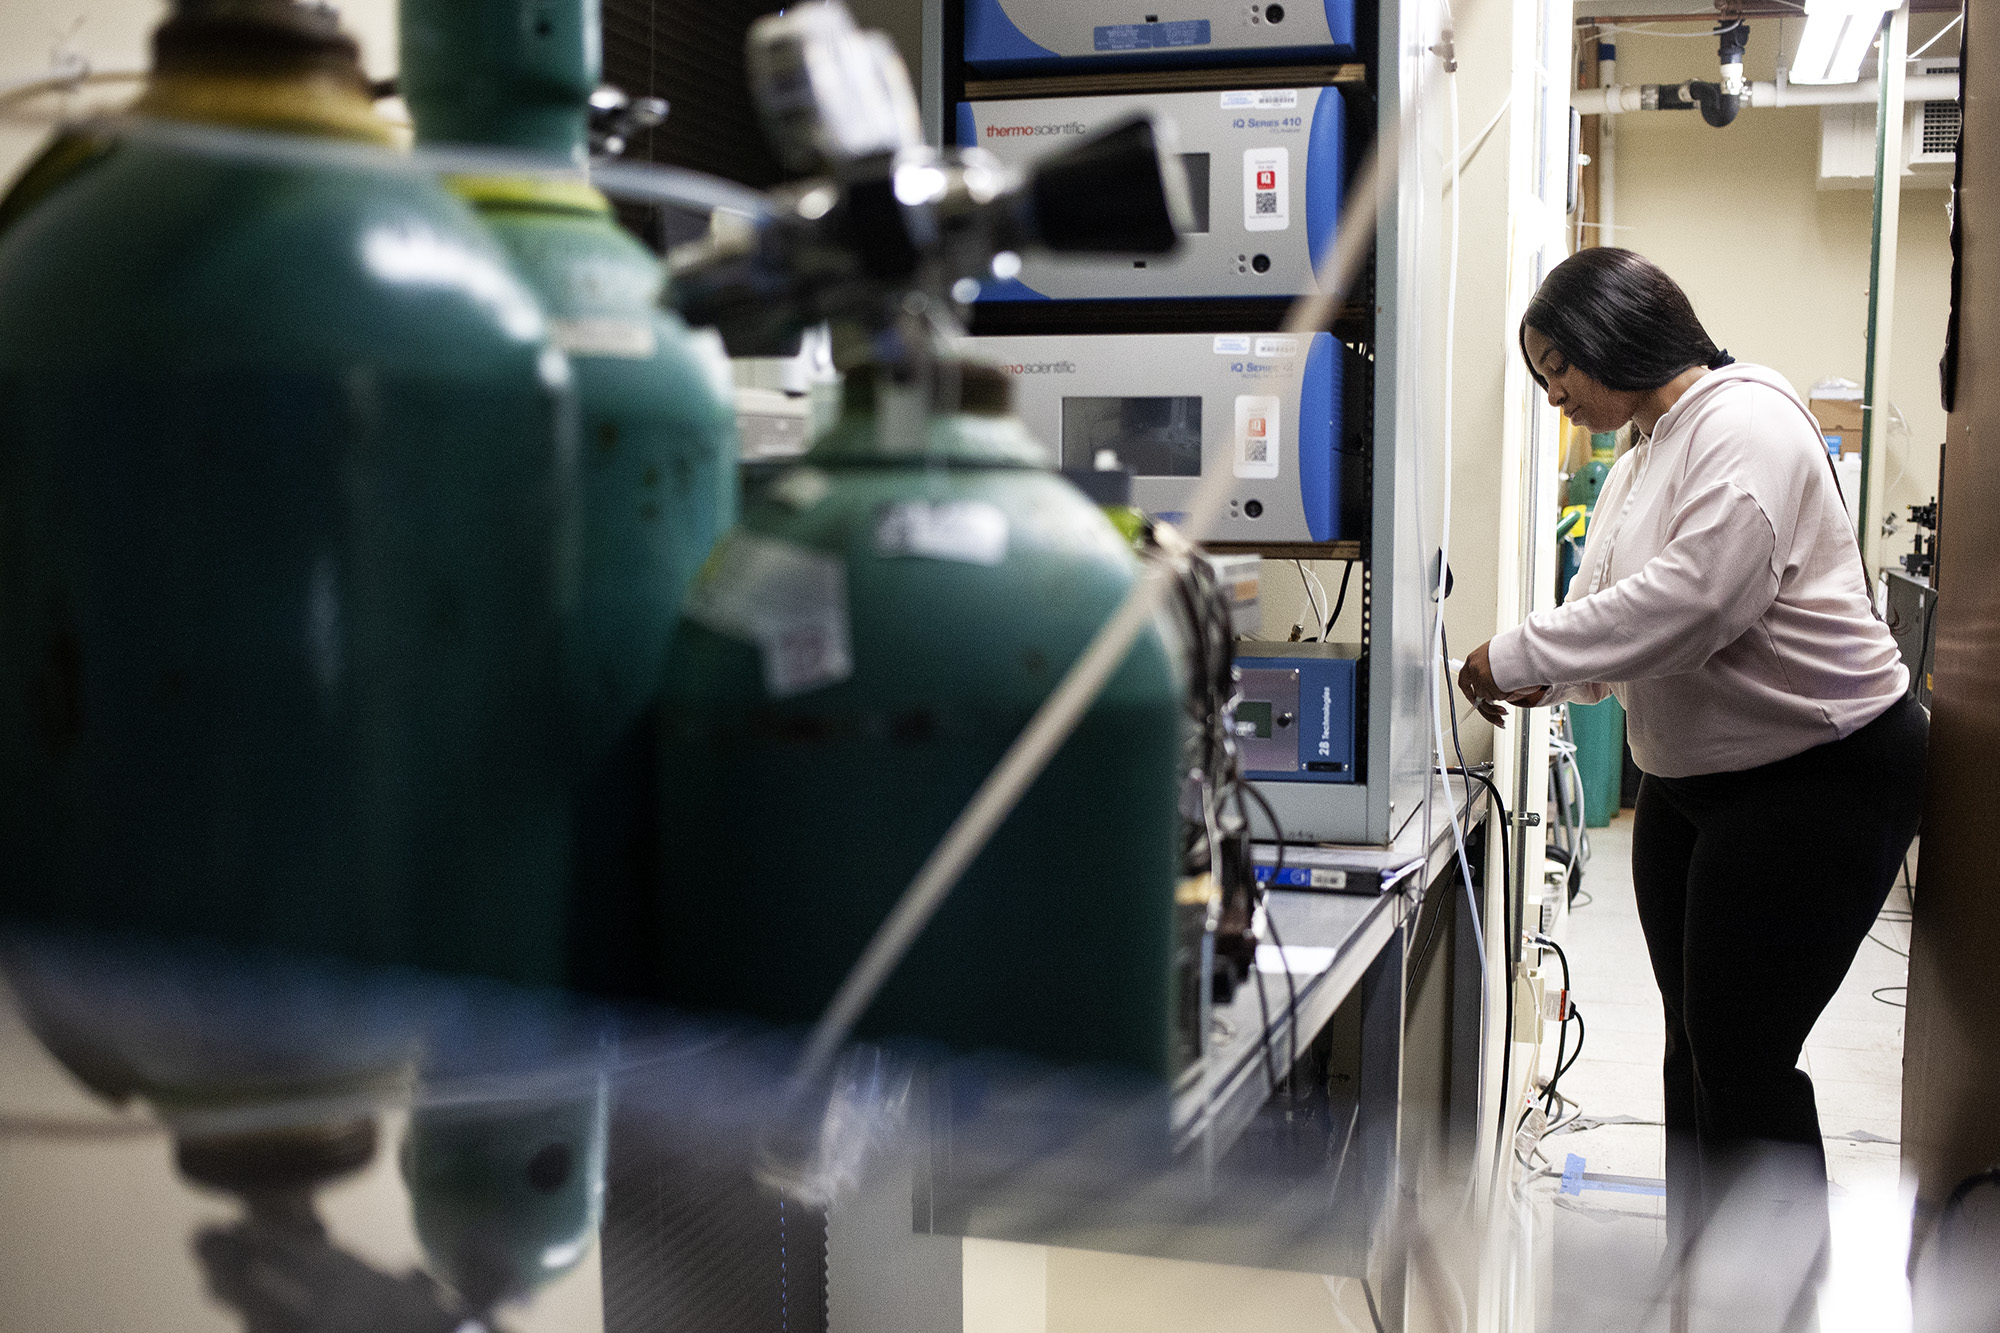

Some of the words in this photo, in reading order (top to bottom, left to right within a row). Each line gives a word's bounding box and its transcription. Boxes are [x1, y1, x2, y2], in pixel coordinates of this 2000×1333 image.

[1282, 116, 1302, 127] 410
[1322, 687, 1331, 739] Technologies
[1318, 741, 1330, 756] 2B
